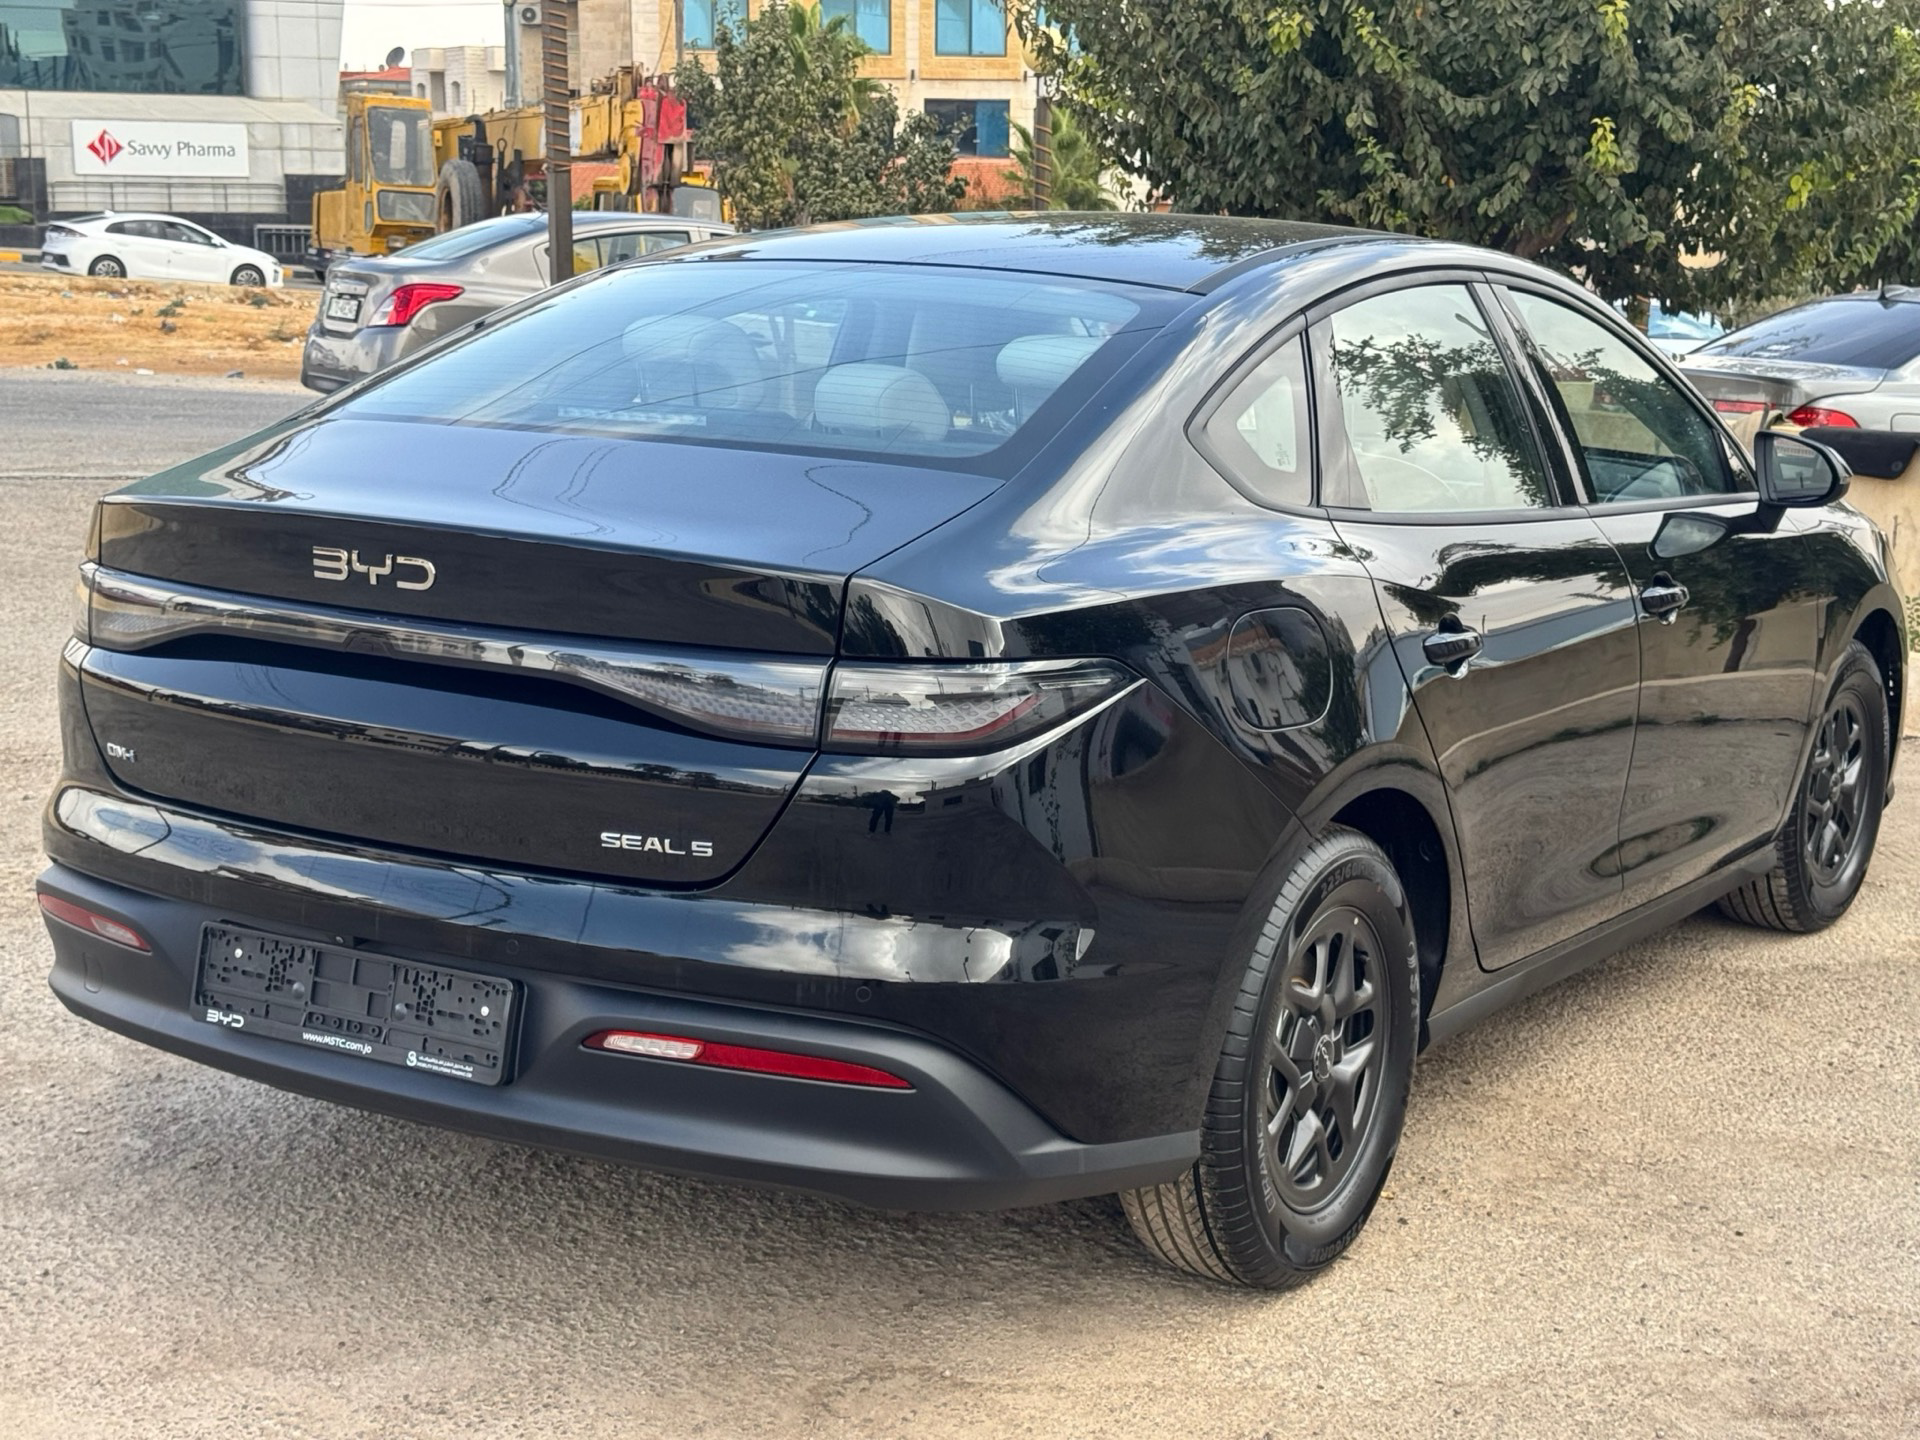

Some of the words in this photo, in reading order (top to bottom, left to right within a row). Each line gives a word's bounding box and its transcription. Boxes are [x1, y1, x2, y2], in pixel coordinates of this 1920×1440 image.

[127, 140, 172, 160] Savvy
[177, 141, 236, 158] Pharma
[312, 545, 436, 591] BYD
[600, 832, 686, 855] SEAL
[691, 840, 713, 857] 5
[206, 1008, 244, 1028] BYD
